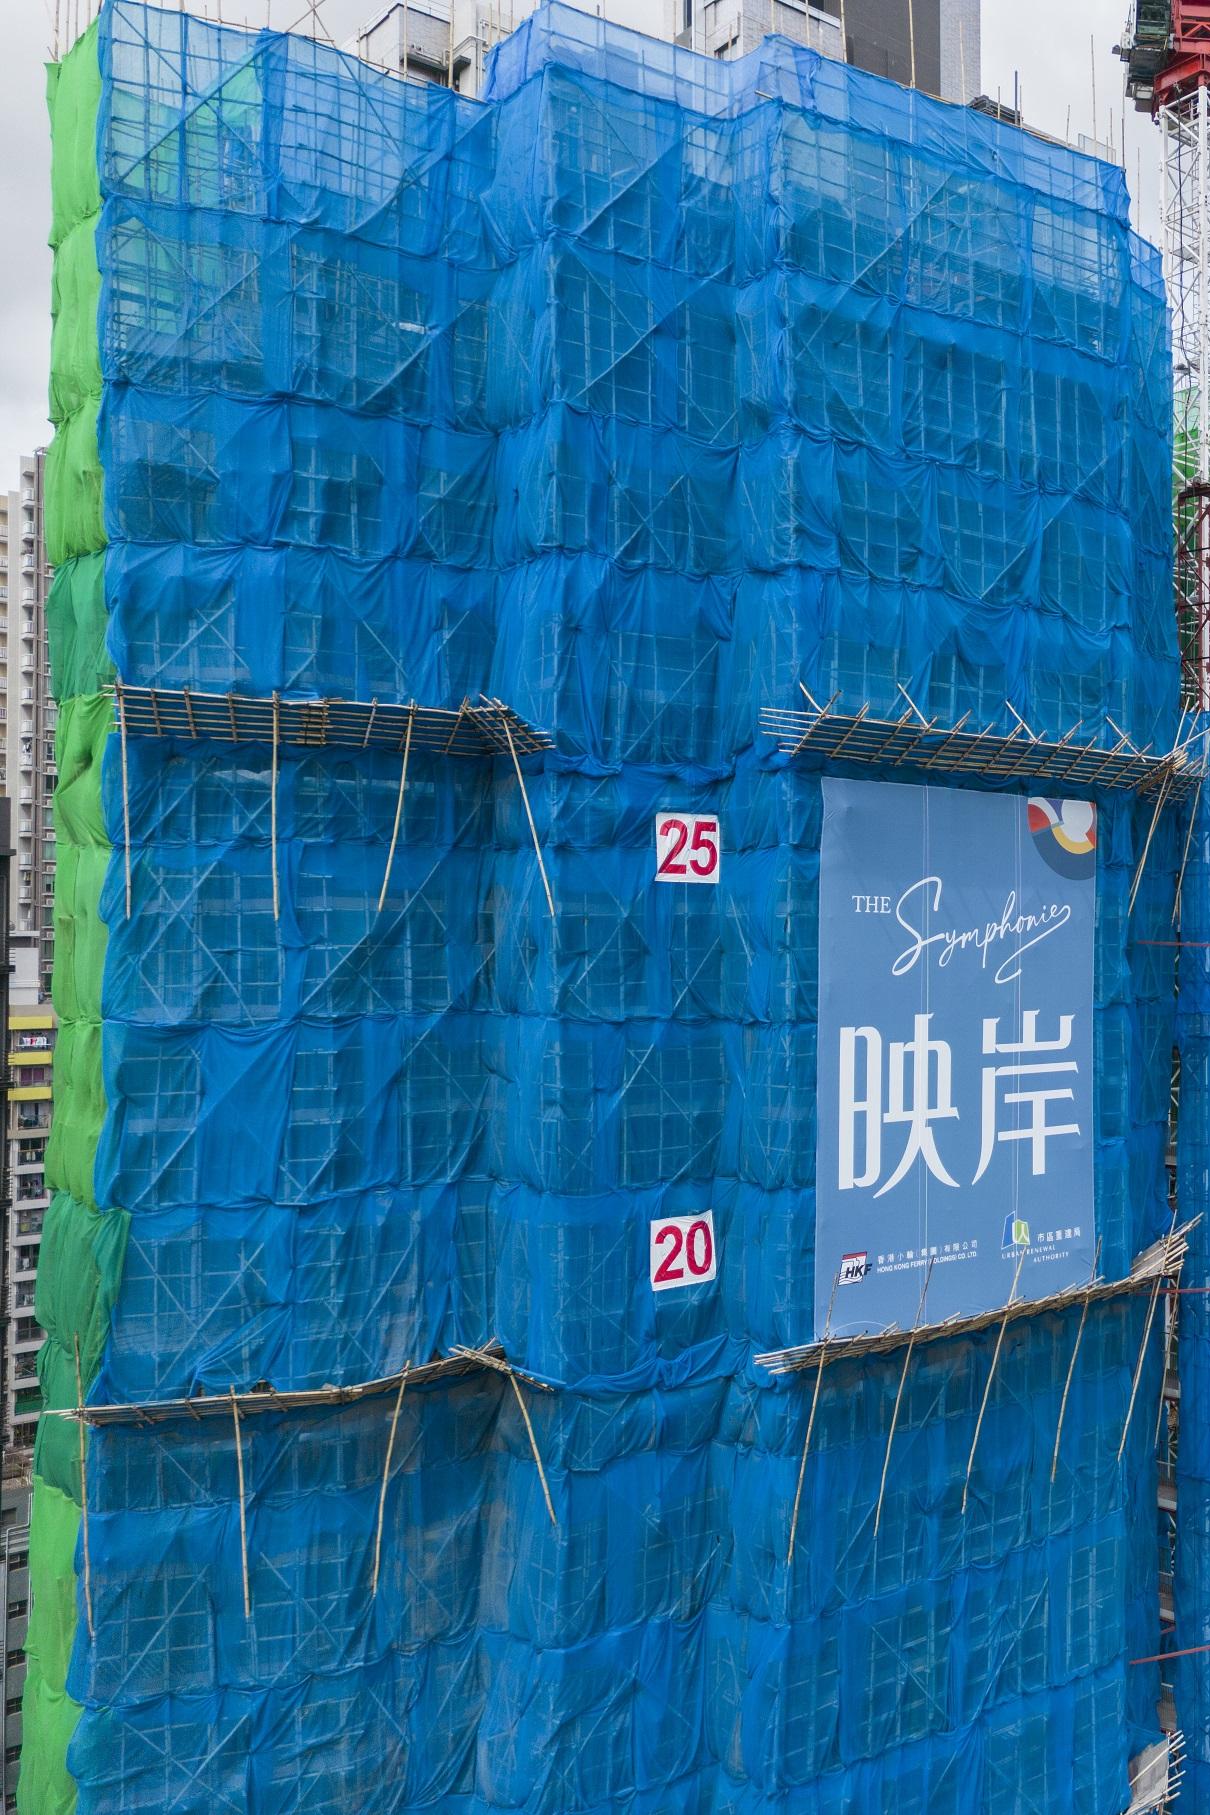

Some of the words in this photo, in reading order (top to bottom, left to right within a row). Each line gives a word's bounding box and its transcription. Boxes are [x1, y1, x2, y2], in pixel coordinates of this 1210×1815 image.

[658, 818, 718, 876] 25
[852, 895, 891, 914] THE
[838, 1008, 1081, 1199] 映岸
[653, 1220, 713, 1283] 20
[1026, 1244, 1056, 1255] RENEWAL
[1033, 1251, 1069, 1263] AUTHORITY
[845, 1263, 873, 1278] HKF
[876, 1265, 893, 1273] HONG
[893, 1262, 910, 1271] KONG
[910, 1260, 927, 1269] FERRY
